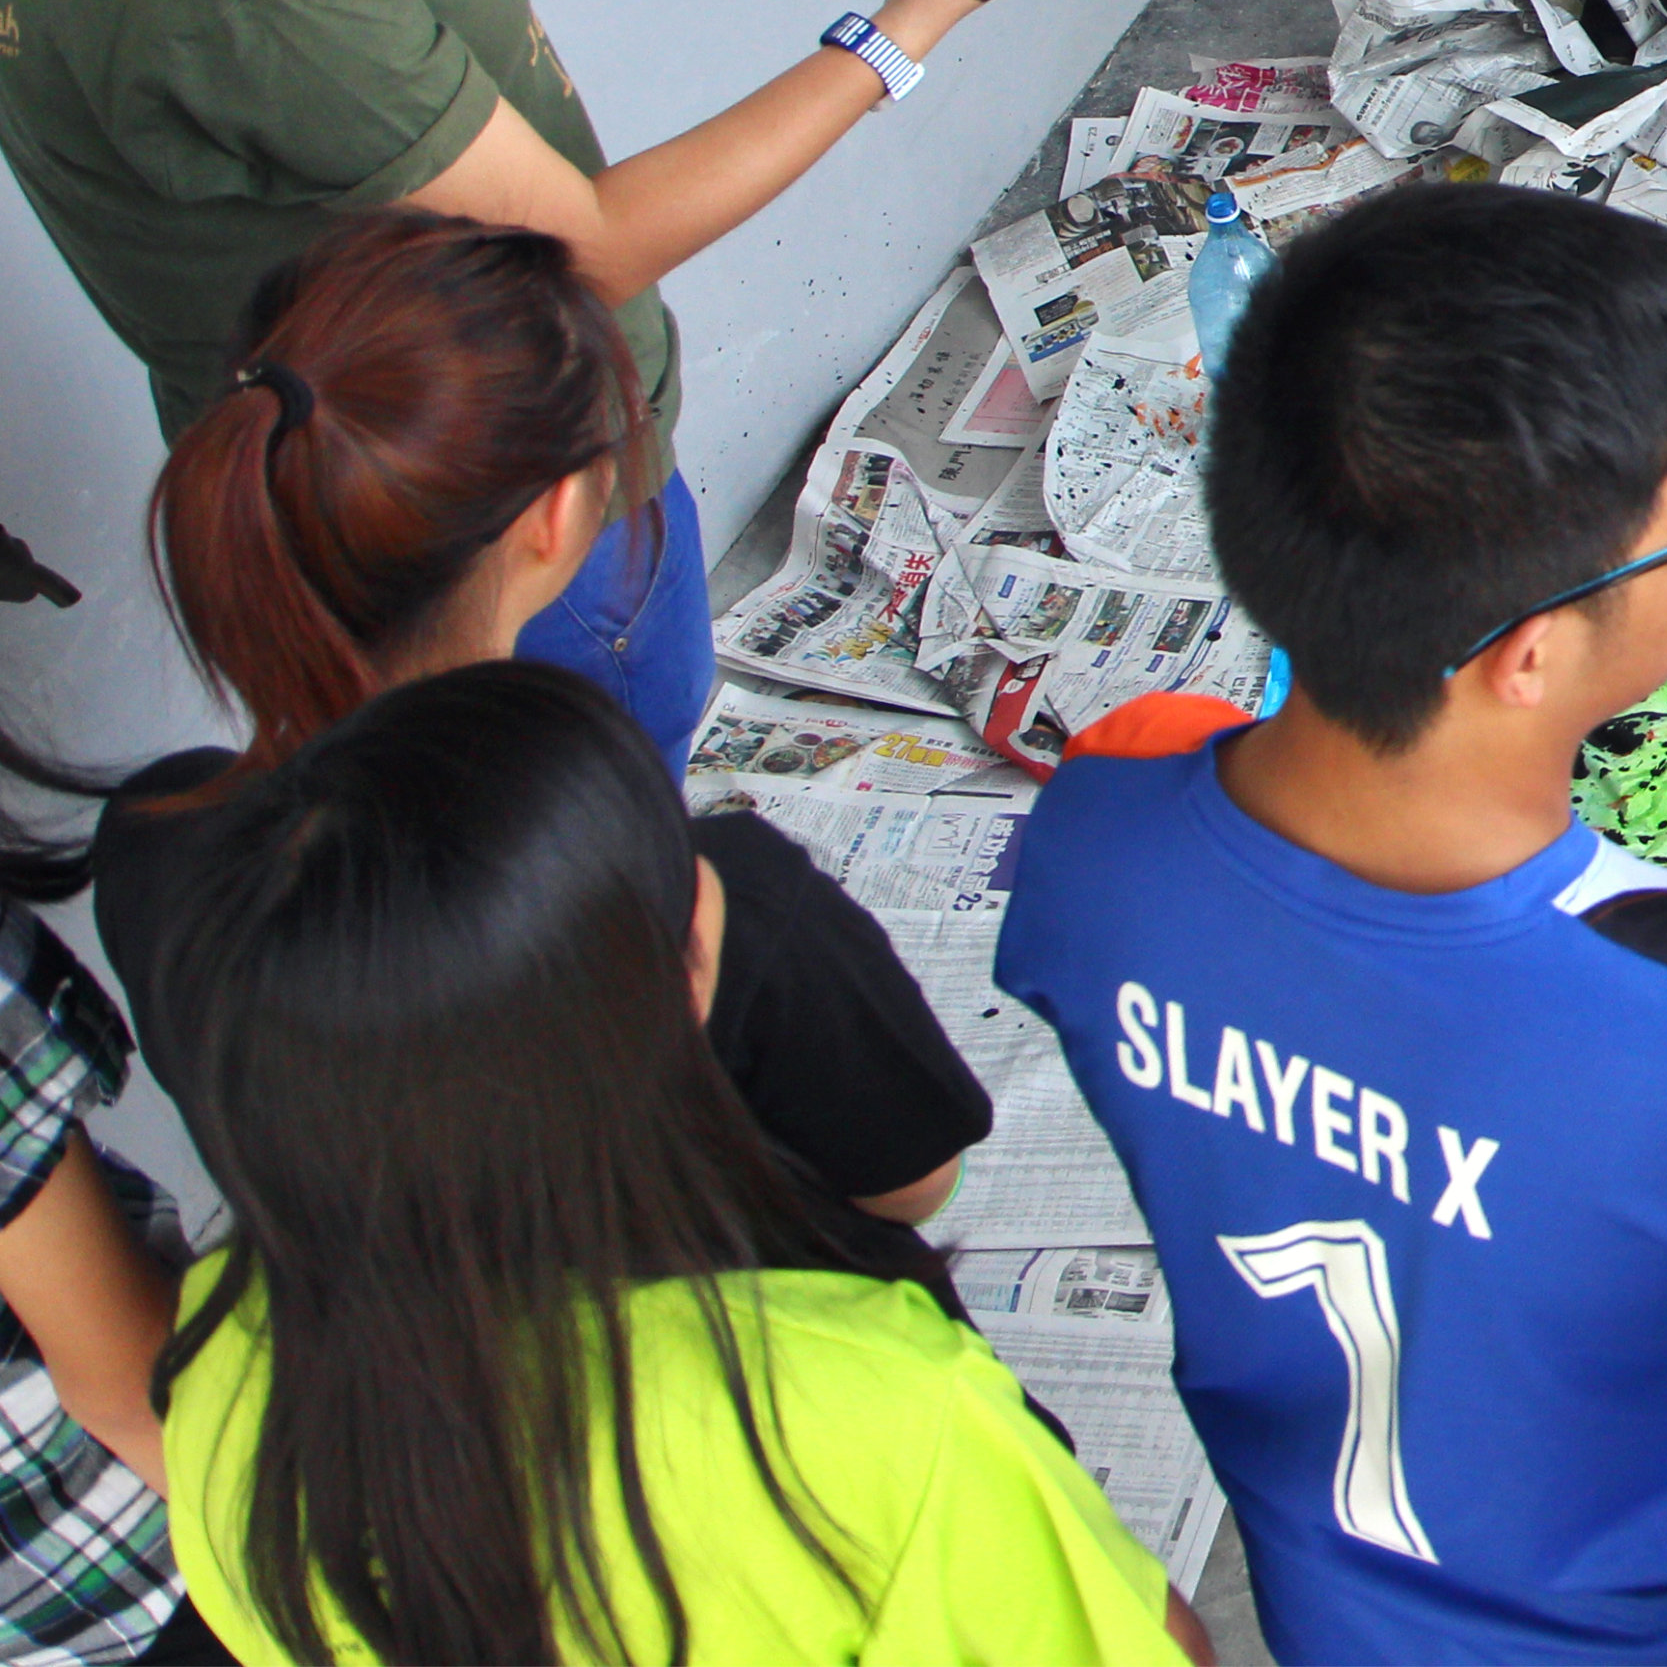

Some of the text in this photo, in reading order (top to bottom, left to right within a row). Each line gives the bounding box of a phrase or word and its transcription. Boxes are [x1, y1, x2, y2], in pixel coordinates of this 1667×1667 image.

[1116, 981, 1500, 1241] SLAYER X
[1215, 1219, 1441, 1565] 7
